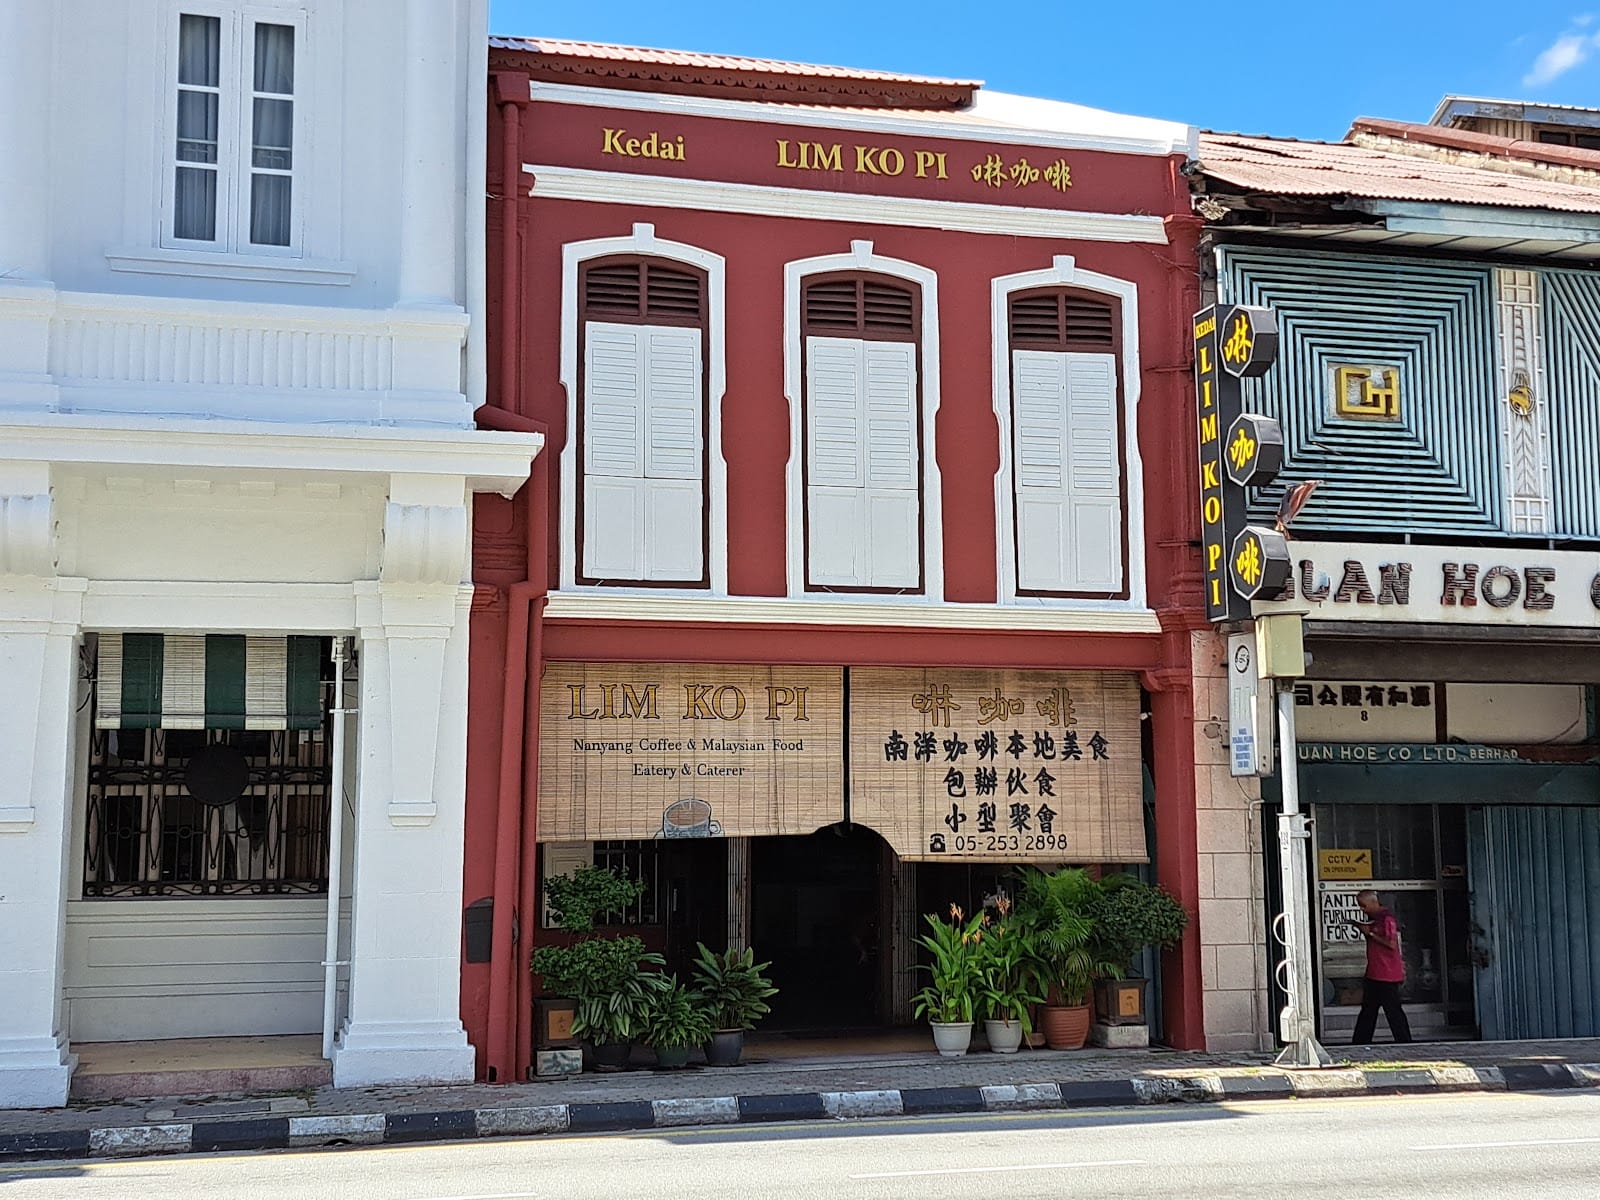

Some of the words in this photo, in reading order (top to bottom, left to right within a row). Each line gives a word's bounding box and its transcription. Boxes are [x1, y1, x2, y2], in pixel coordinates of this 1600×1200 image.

[602, 127, 686, 161] Kedai
[776, 139, 842, 172] LIM
[855, 145, 905, 176] KO
[915, 150, 949, 180] PI
[1195, 316, 1216, 339] KEDAI
[1200, 346, 1217, 445] LIM
[1203, 461, 1221, 524] KO
[1208, 543, 1221, 606] PI
[1274, 559, 1413, 606] UAN
[1441, 562, 1556, 610] HOE
[567, 683, 660, 719] LIM
[683, 683, 747, 721] KO
[765, 686, 809, 721] PI
[1360, 710, 1369, 722] 8
[573, 738, 633, 755] Nanyang
[639, 738, 682, 751] Coffee
[687, 739, 696, 751] &
[702, 738, 765, 754] Malaysian
[773, 738, 804, 751] Food
[884, 729, 1110, 762] 南洋咖啡本地美食
[1298, 746, 1333, 760] UAN
[1340, 745, 1377, 760] HOE
[1388, 746, 1411, 760] CO
[1469, 748, 1519, 760] BERHAD
[633, 763, 677, 780] Eatery
[681, 764, 692, 776] &
[697, 764, 745, 777] Caterer
[943, 766, 1057, 798] 包辦伙食
[945, 802, 1058, 834] 小型聚會
[955, 835, 1019, 851] 05-253
[1026, 834, 1068, 850] 2898
[1328, 856, 1351, 864] CCTV
[1324, 894, 1359, 908] ANTI
[1327, 925, 1349, 940] FOR
